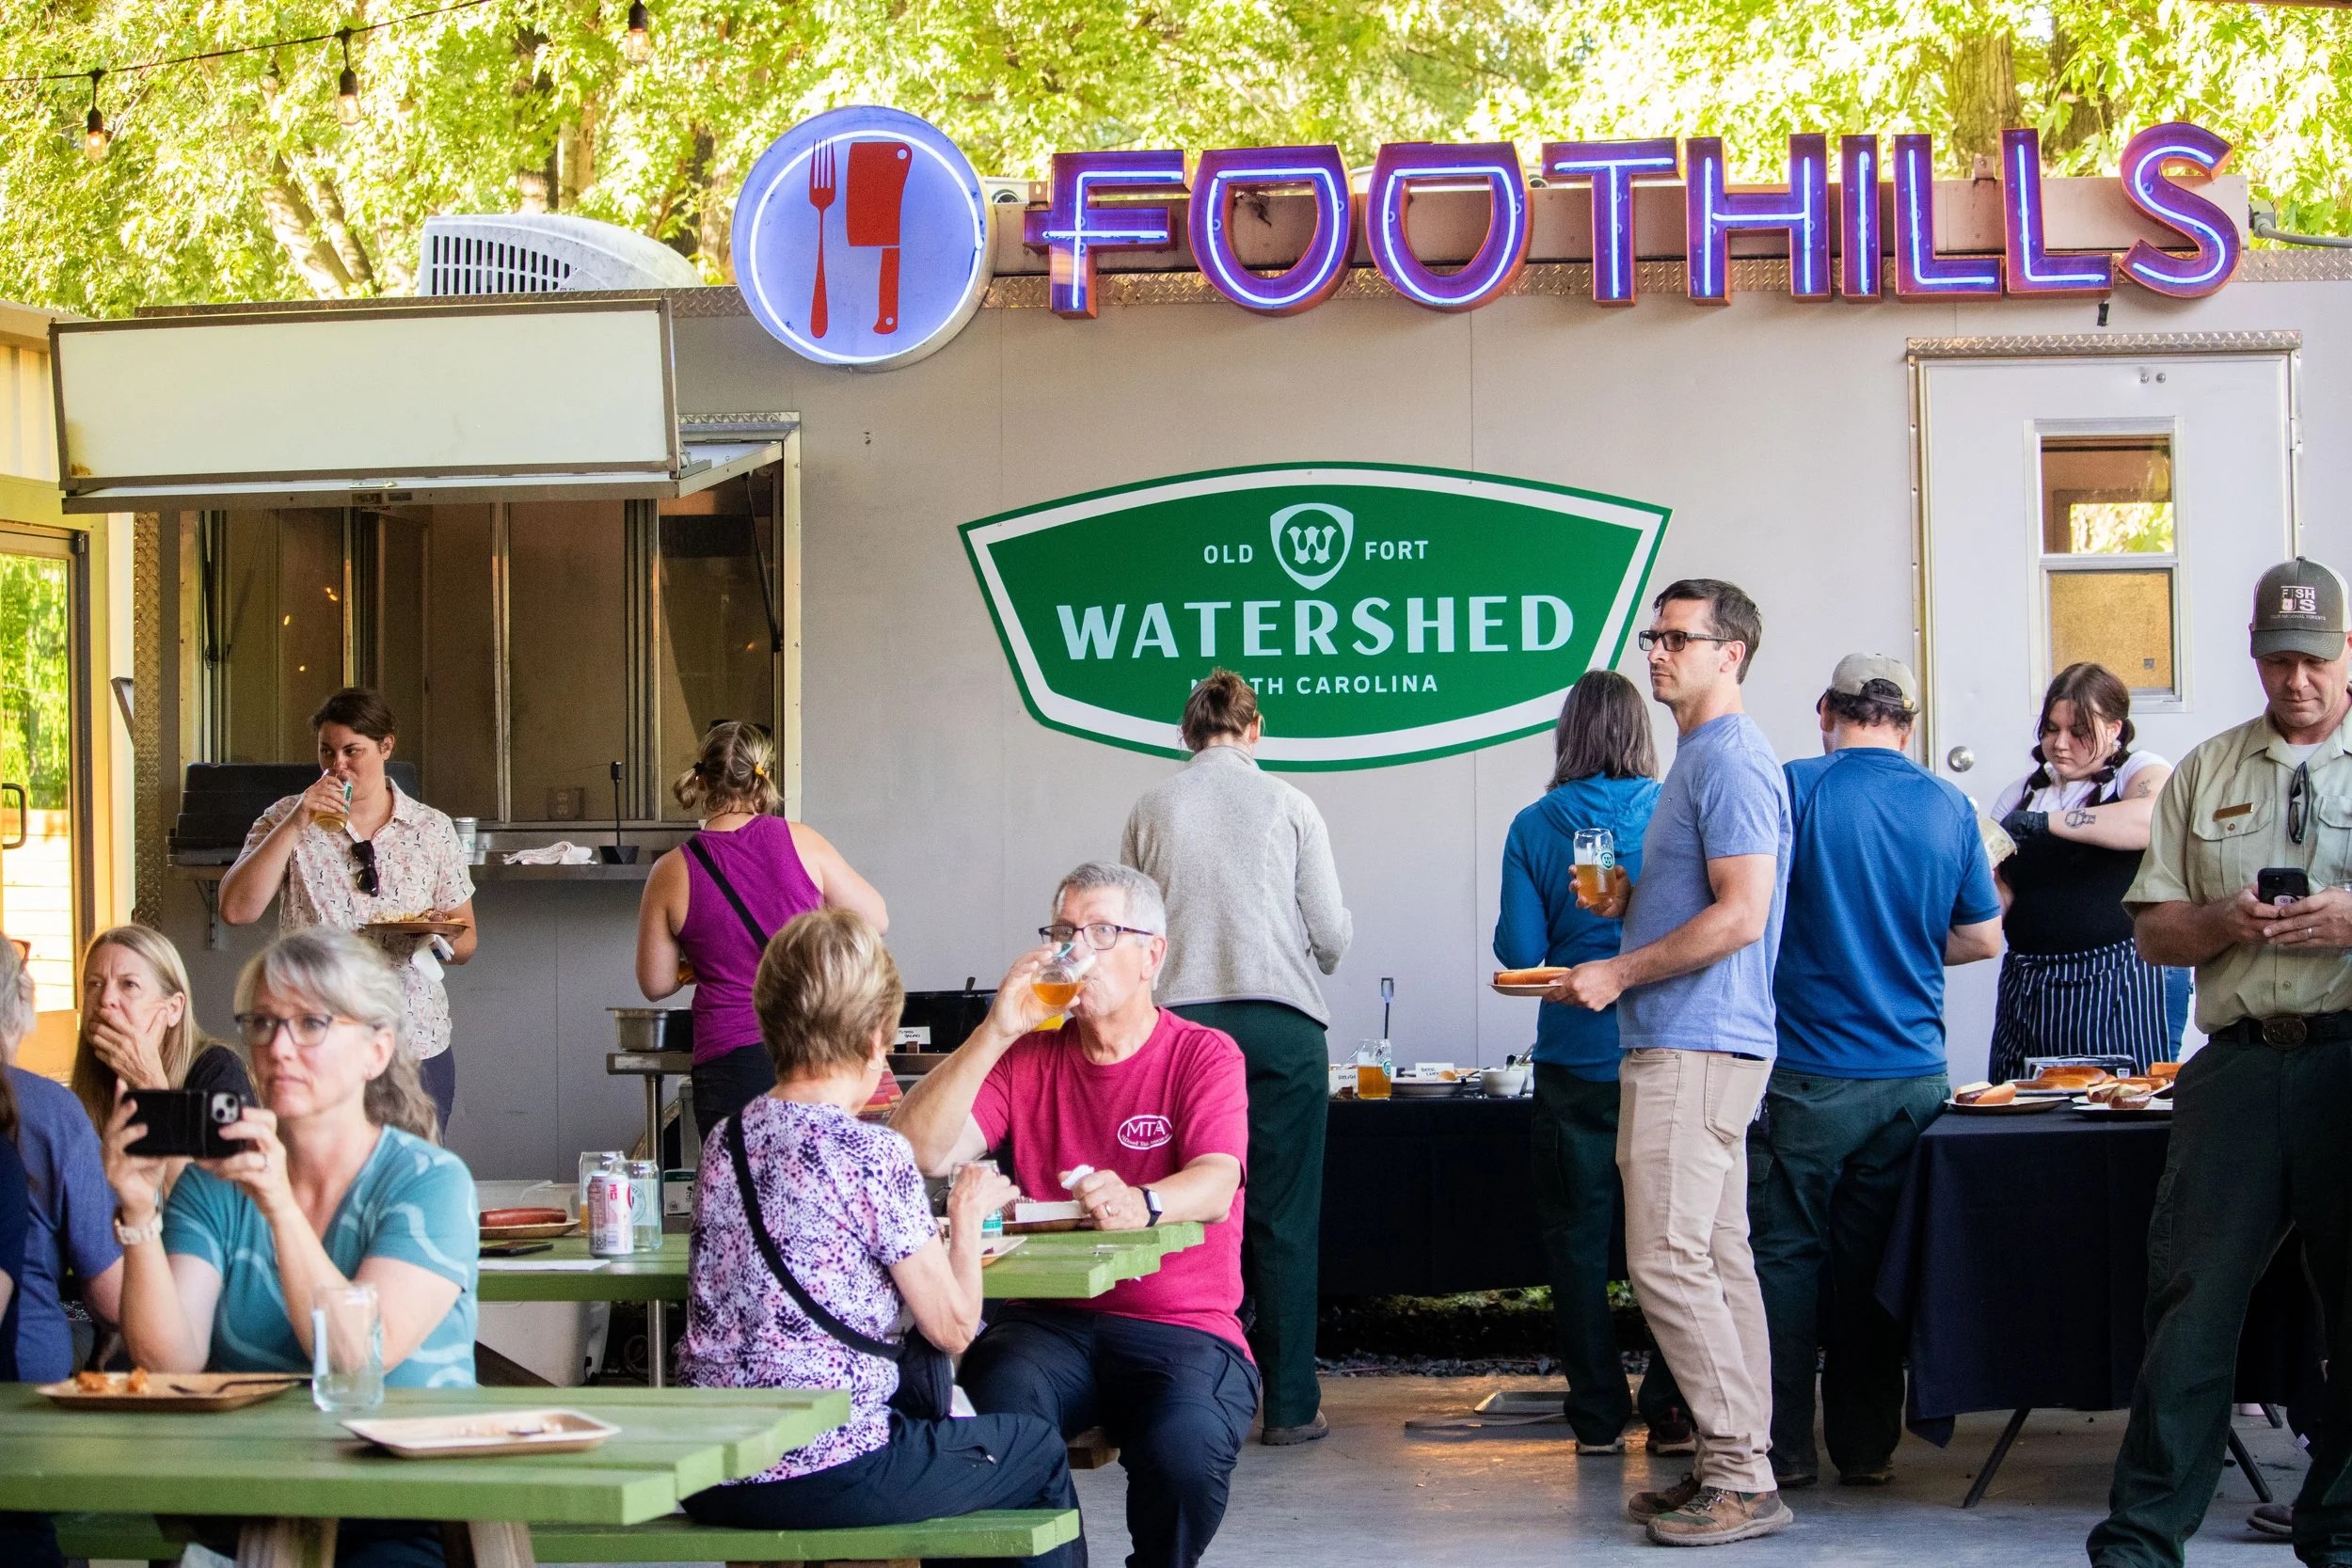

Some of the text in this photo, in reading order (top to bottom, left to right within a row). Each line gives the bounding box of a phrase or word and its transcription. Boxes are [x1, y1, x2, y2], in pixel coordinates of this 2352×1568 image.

[1024, 122, 2242, 319] FOOTHILLS
[1203, 540, 1429, 564] OLD FORT
[2281, 588, 2315, 600] FISH
[1056, 594, 1575, 660] WATERSHED
[1295, 674, 1438, 695] CAROLINA
[1126, 1119, 1166, 1137] MTA
